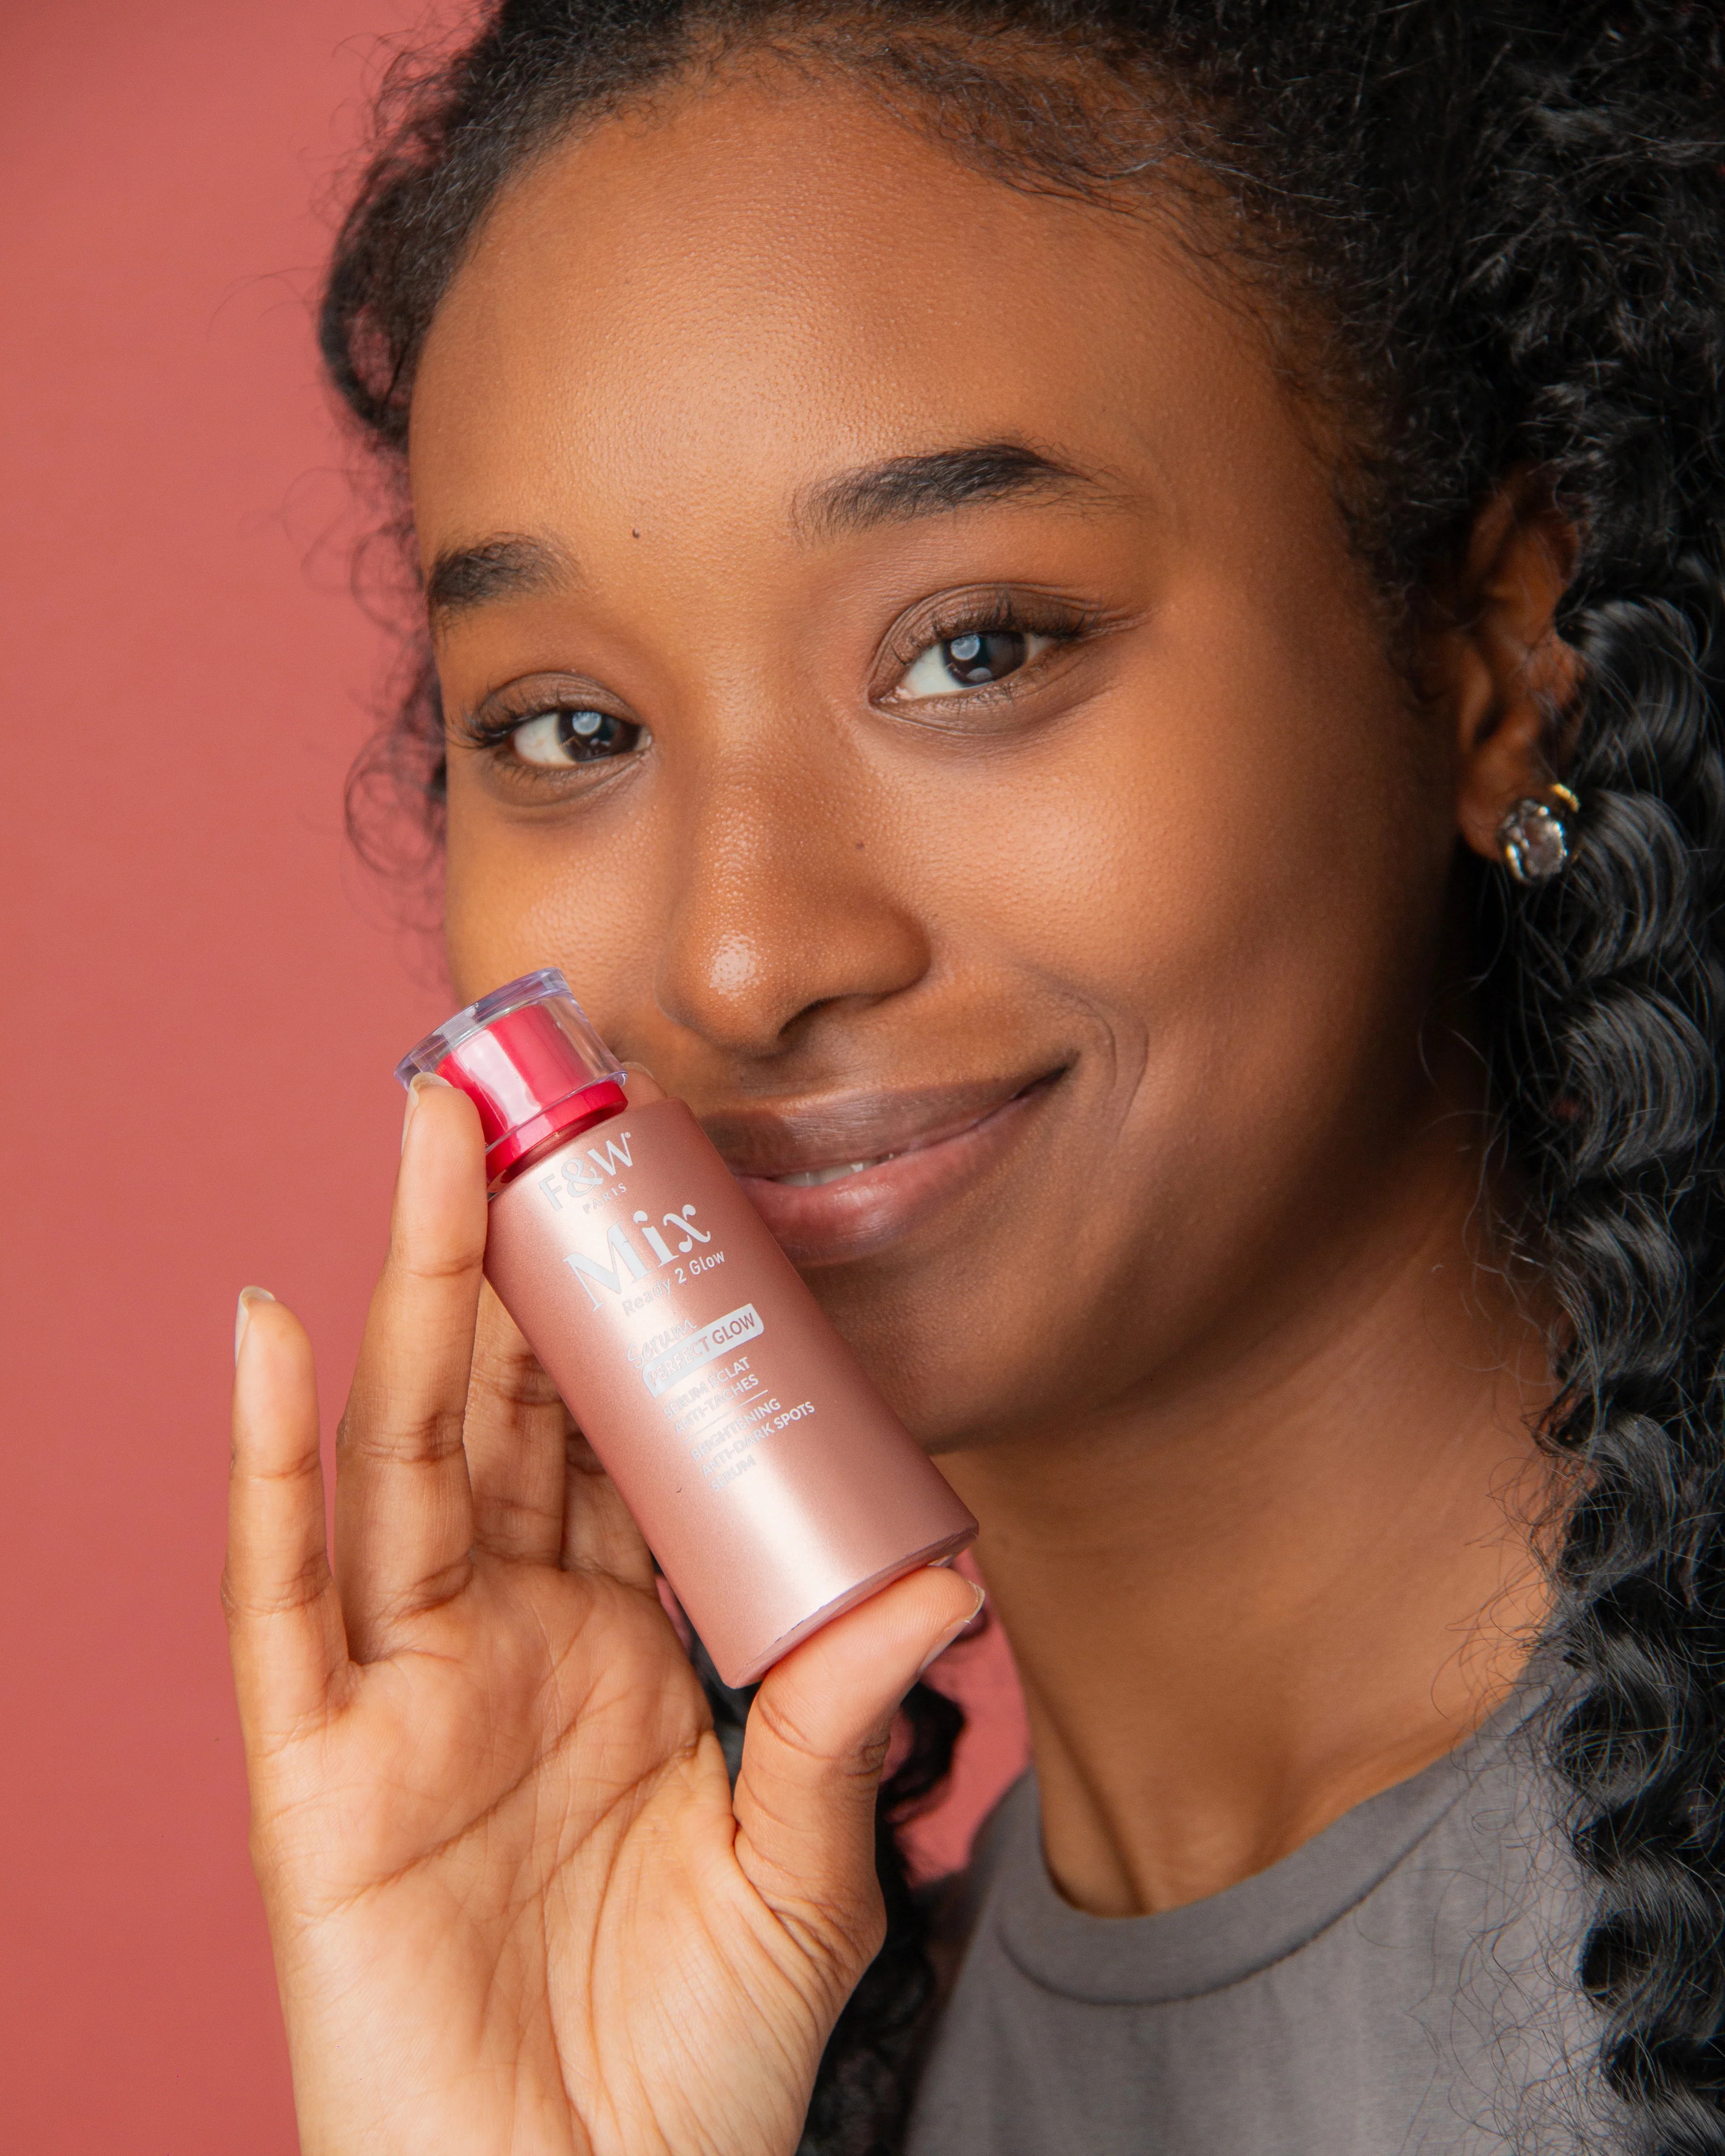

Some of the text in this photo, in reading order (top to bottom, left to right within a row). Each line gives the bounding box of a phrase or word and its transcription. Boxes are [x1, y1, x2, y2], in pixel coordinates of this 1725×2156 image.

[582, 1182, 627, 1214] PARIS
[562, 1204, 711, 1312] Mix
[622, 1251, 725, 1317] Ready 2 Glow
[627, 1319, 697, 1369] Serum
[647, 1312, 756, 1387] PERFECT GLOW
[663, 1356, 750, 1419] SÉRUM ÉCLAT
[674, 1374, 759, 1435] ANTI-TACHES
[690, 1398, 781, 1462] BRIGHTENING
[701, 1401, 815, 1478] ANTI-DARK SPOTS
[710, 1454, 757, 1493] SERUM
